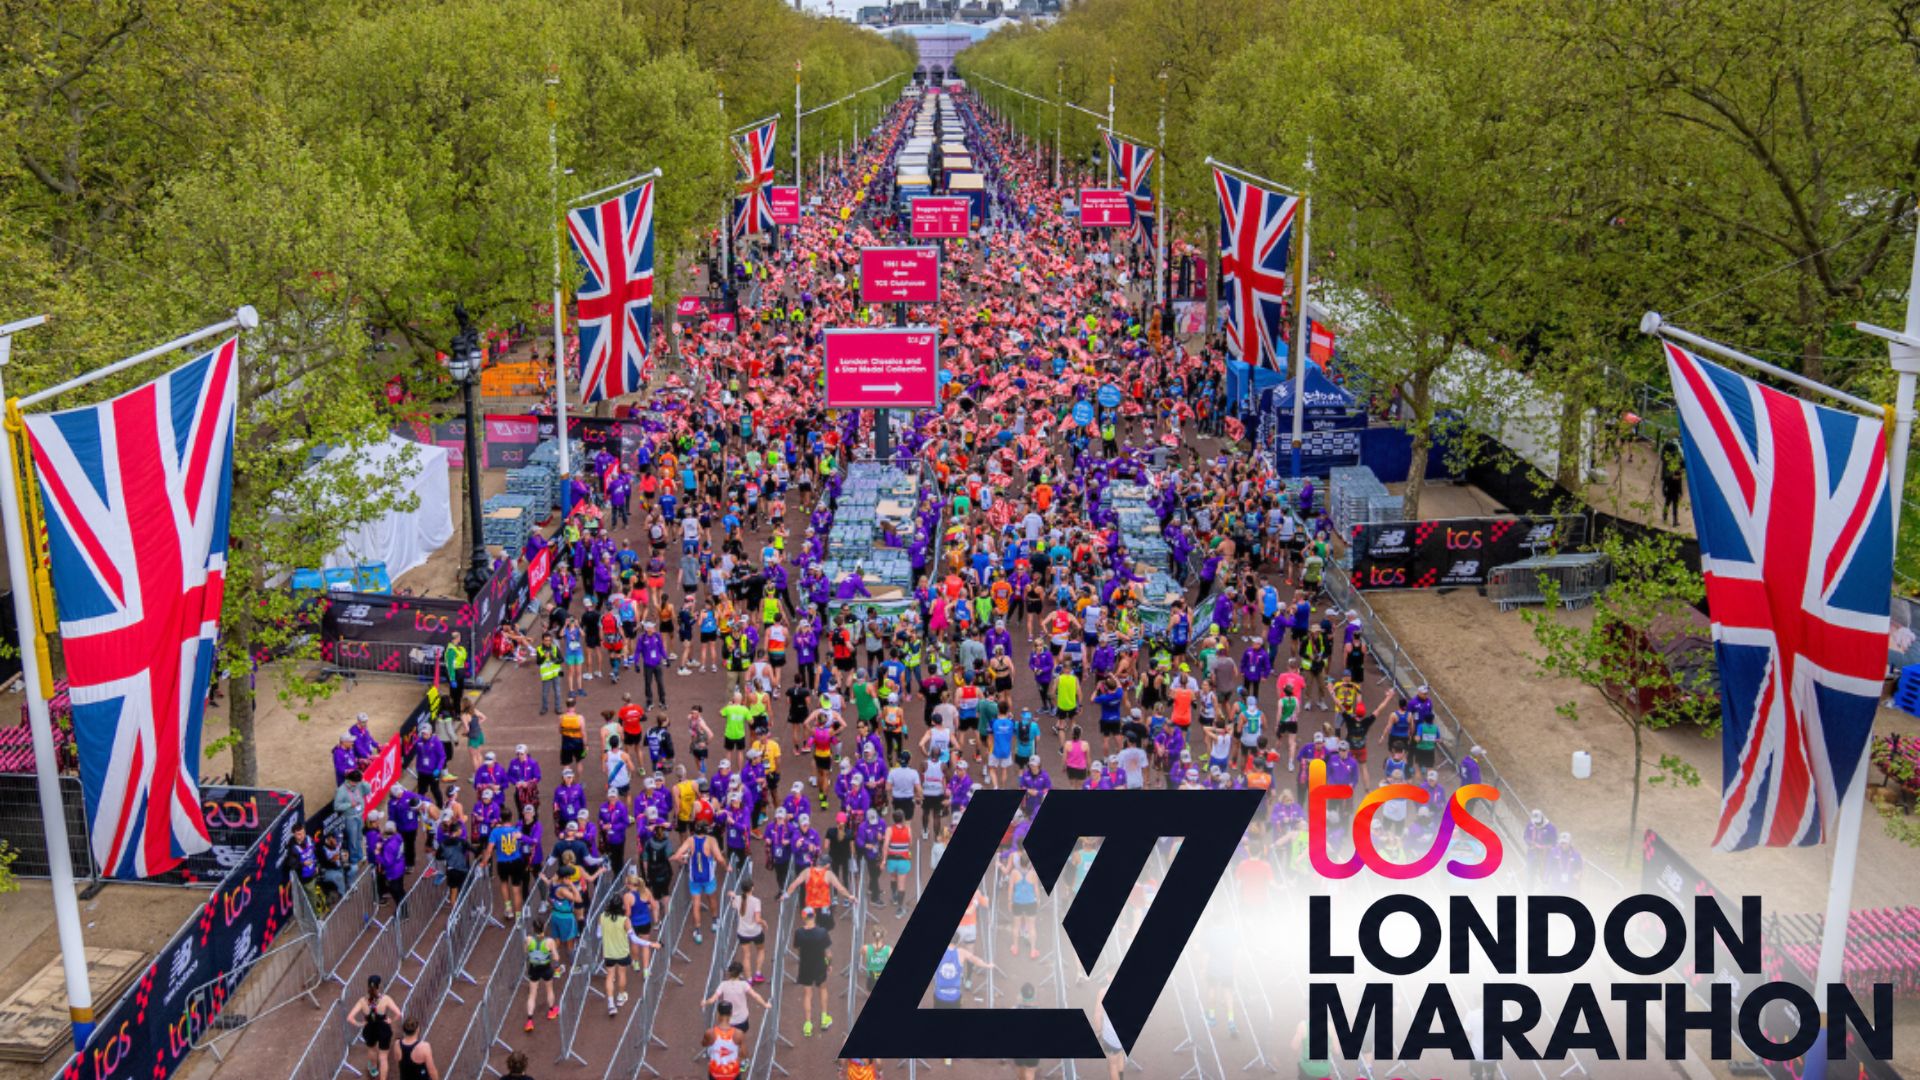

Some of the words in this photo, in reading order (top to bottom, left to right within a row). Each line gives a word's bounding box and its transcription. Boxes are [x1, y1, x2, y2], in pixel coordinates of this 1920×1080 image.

[890, 279, 926, 287] Clubhouse
[583, 426, 607, 443] tcs
[1446, 527, 1483, 550] tcs
[1370, 565, 1407, 586] tcs
[415, 609, 449, 633] tcs
[338, 635, 371, 659] tcs
[223, 875, 252, 927] tcs
[278, 880, 294, 916] tc
[168, 1000, 201, 1059] tcs
[93, 1020, 132, 1080] tcs
